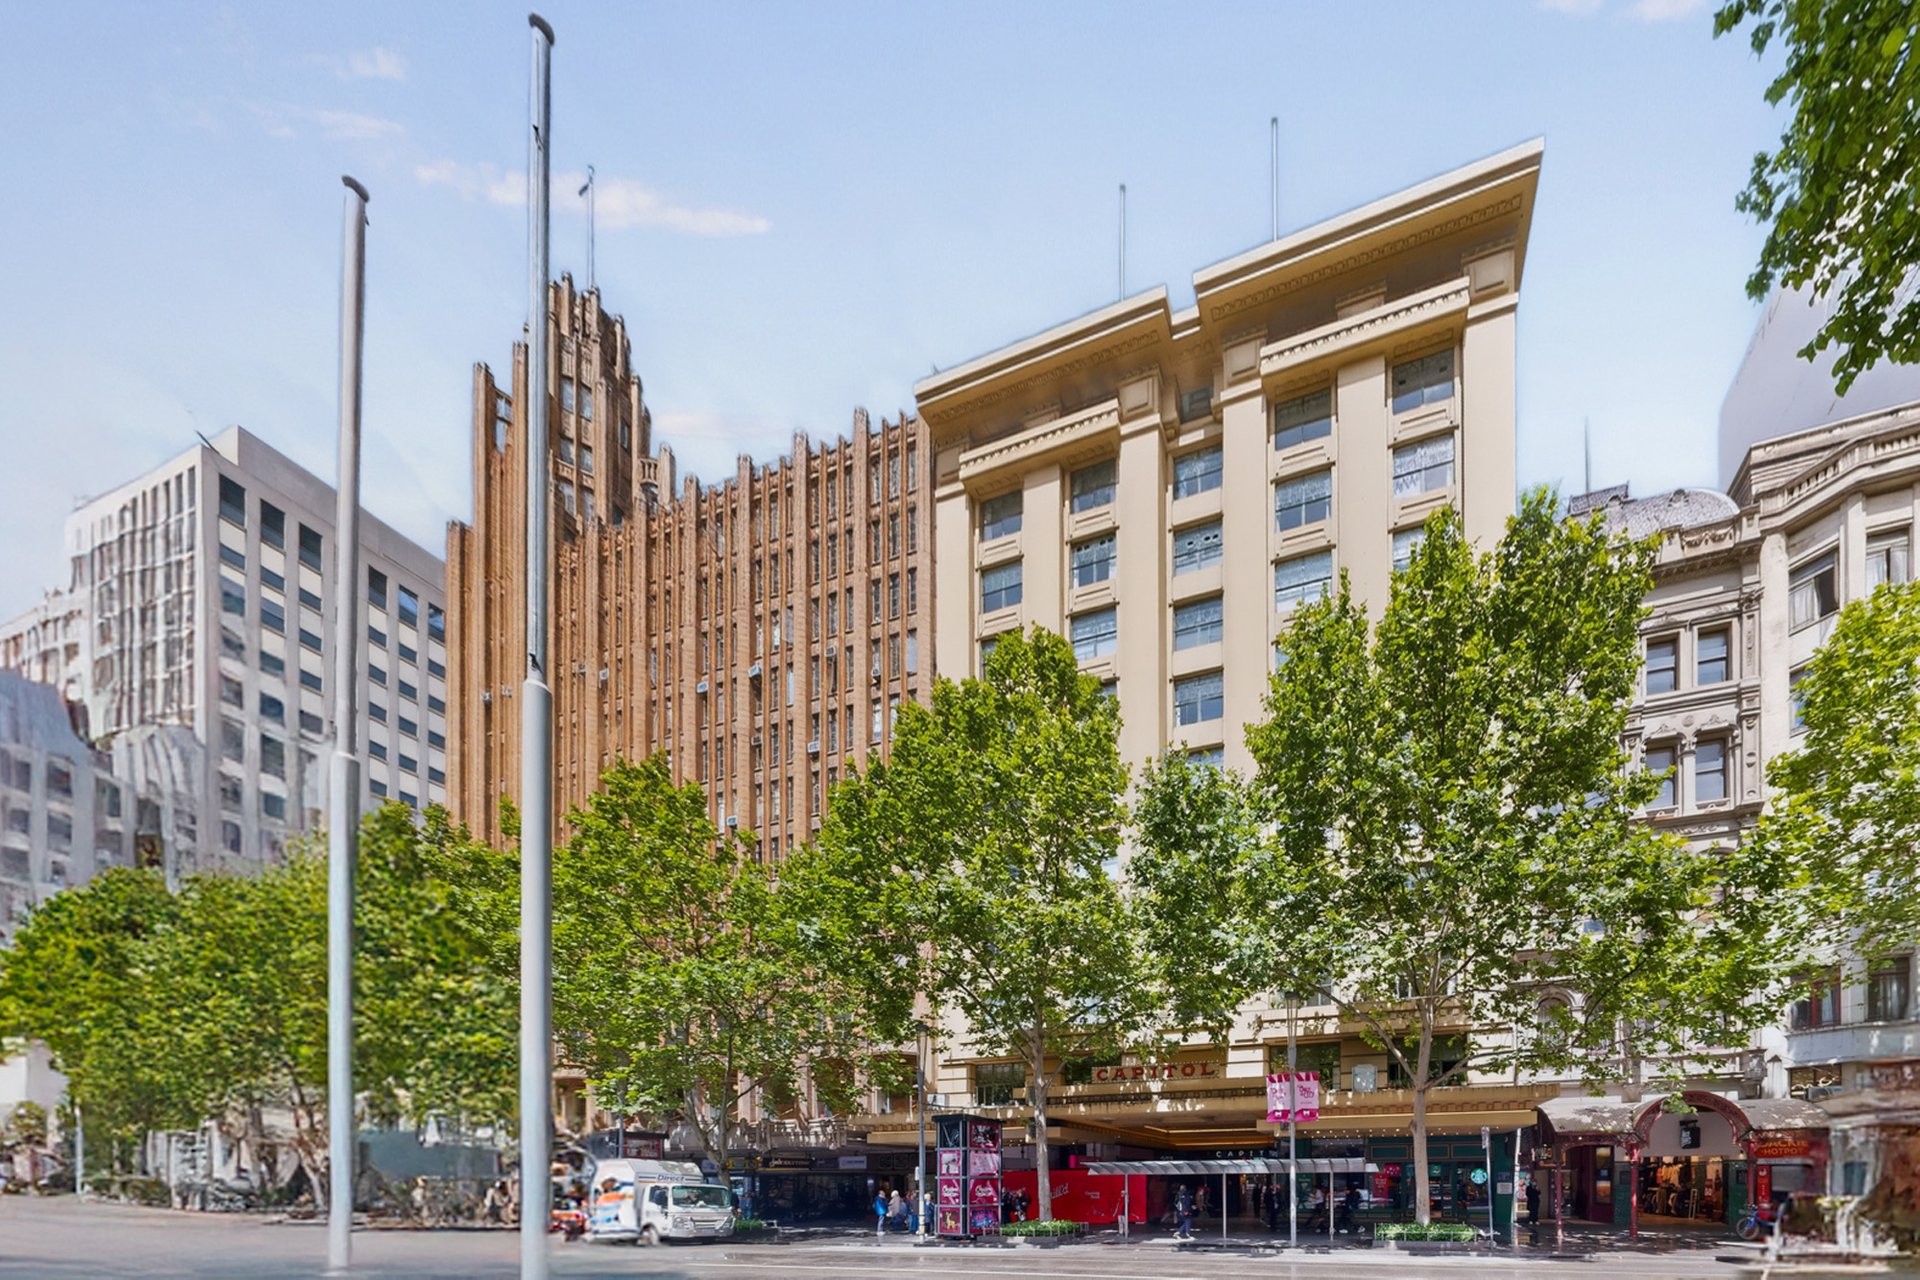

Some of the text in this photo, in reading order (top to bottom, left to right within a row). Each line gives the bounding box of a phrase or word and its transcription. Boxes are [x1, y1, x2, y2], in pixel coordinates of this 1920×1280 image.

[1096, 1063, 1215, 1081] CAPITOL
[1216, 1150, 1264, 1158] CAPIT
[656, 1173, 685, 1181] Direct
